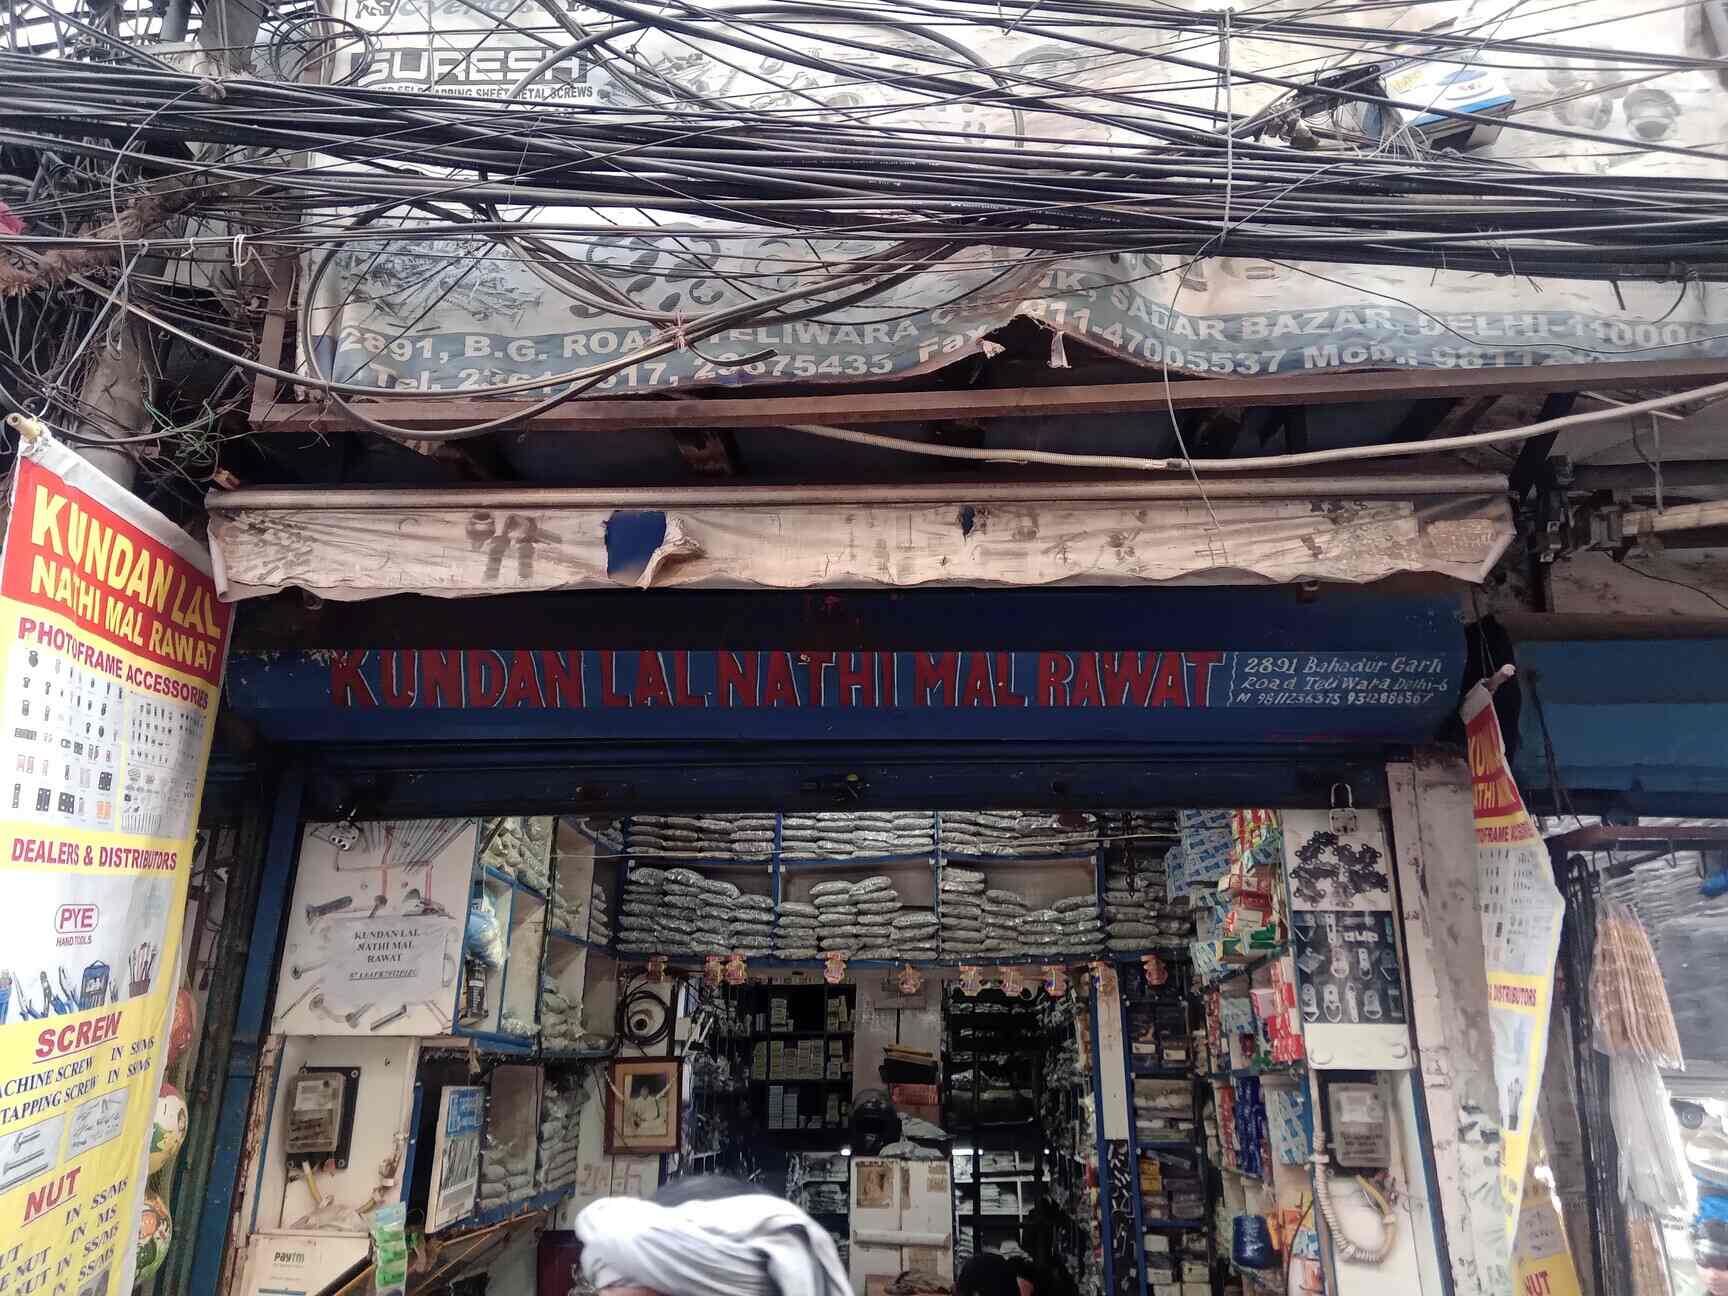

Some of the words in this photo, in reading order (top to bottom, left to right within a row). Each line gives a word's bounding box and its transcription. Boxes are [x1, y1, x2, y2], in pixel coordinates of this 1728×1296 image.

[514, 87, 546, 100] ETAL
[550, 86, 593, 99] SCREWS
[463, 334, 548, 362] B.G.
[562, 329, 660, 358] ROA
[1111, 285, 1226, 341] SADAR
[31, 484, 175, 614] KUNDAN
[171, 574, 222, 640] LAL
[30, 554, 101, 625] NATHI
[104, 596, 144, 647] MAL
[148, 620, 217, 672] RAWAT
[17, 616, 124, 679] PHOTOFRAME
[125, 663, 209, 711] ACCESSORIES
[331, 650, 588, 708] KUNDAN
[599, 650, 711, 708] LAL
[719, 650, 900, 707] NATHI
[915, 650, 1031, 707] MAL
[1038, 650, 1228, 707] RAWAT
[1244, 656, 1298, 674] 2891
[1302, 656, 1388, 673] Bahadur
[1391, 655, 1443, 673] Garh
[1236, 692, 1252, 703] M
[1240, 676, 1297, 690] Road
[11, 837, 80, 866] DEALERS
[83, 845, 94, 867] &
[98, 846, 178, 871] DISTRIBUTORS
[59, 907, 95, 930] PYE
[34, 1010, 123, 1058] SCREW
[55, 1055, 97, 1082] SCREW
[110, 1046, 125, 1062] IN
[0, 1090, 62, 1126] TAPPING
[63, 1074, 100, 1103] SCREW
[106, 1067, 121, 1084] IN
[23, 1166, 82, 1222] NUT
[65, 1203, 82, 1226] IN
[70, 1222, 88, 1245] IN
[56, 1253, 73, 1277] IN
